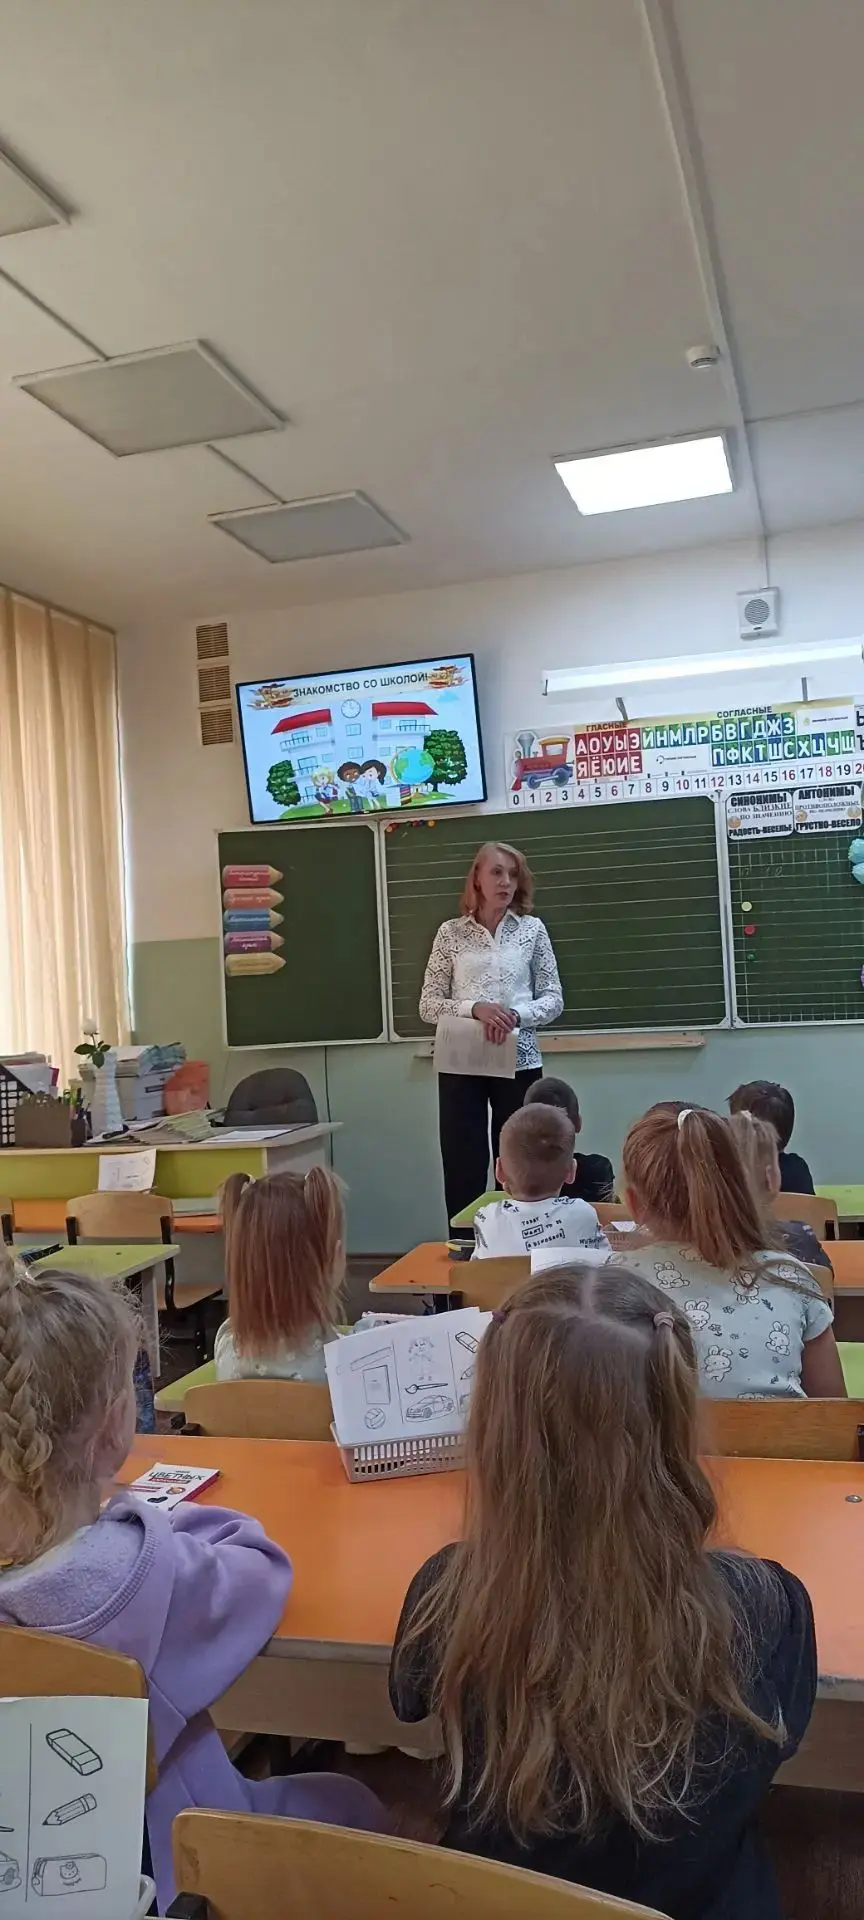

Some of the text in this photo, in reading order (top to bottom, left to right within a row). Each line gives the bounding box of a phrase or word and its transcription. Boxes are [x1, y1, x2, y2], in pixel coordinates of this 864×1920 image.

[293, 672, 429, 698] ЗНАКОМСТВО СО ШКОЛОЙ!
[717, 705, 773, 718] СОГЛАСНЫЕ
[586, 721, 627, 732] ГЛАСНЫЕ
[513, 762, 864, 805] 0 1 2 3 4 5 6 7 8 9 10 11 12 13 14 15 16 17 18 19 2
[798, 785, 855, 800] АНТОНИМЫ
[731, 793, 787, 807] СИНОНИМЫ
[795, 818, 861, 831] ГРУСТНО-ВЕСЕЛО
